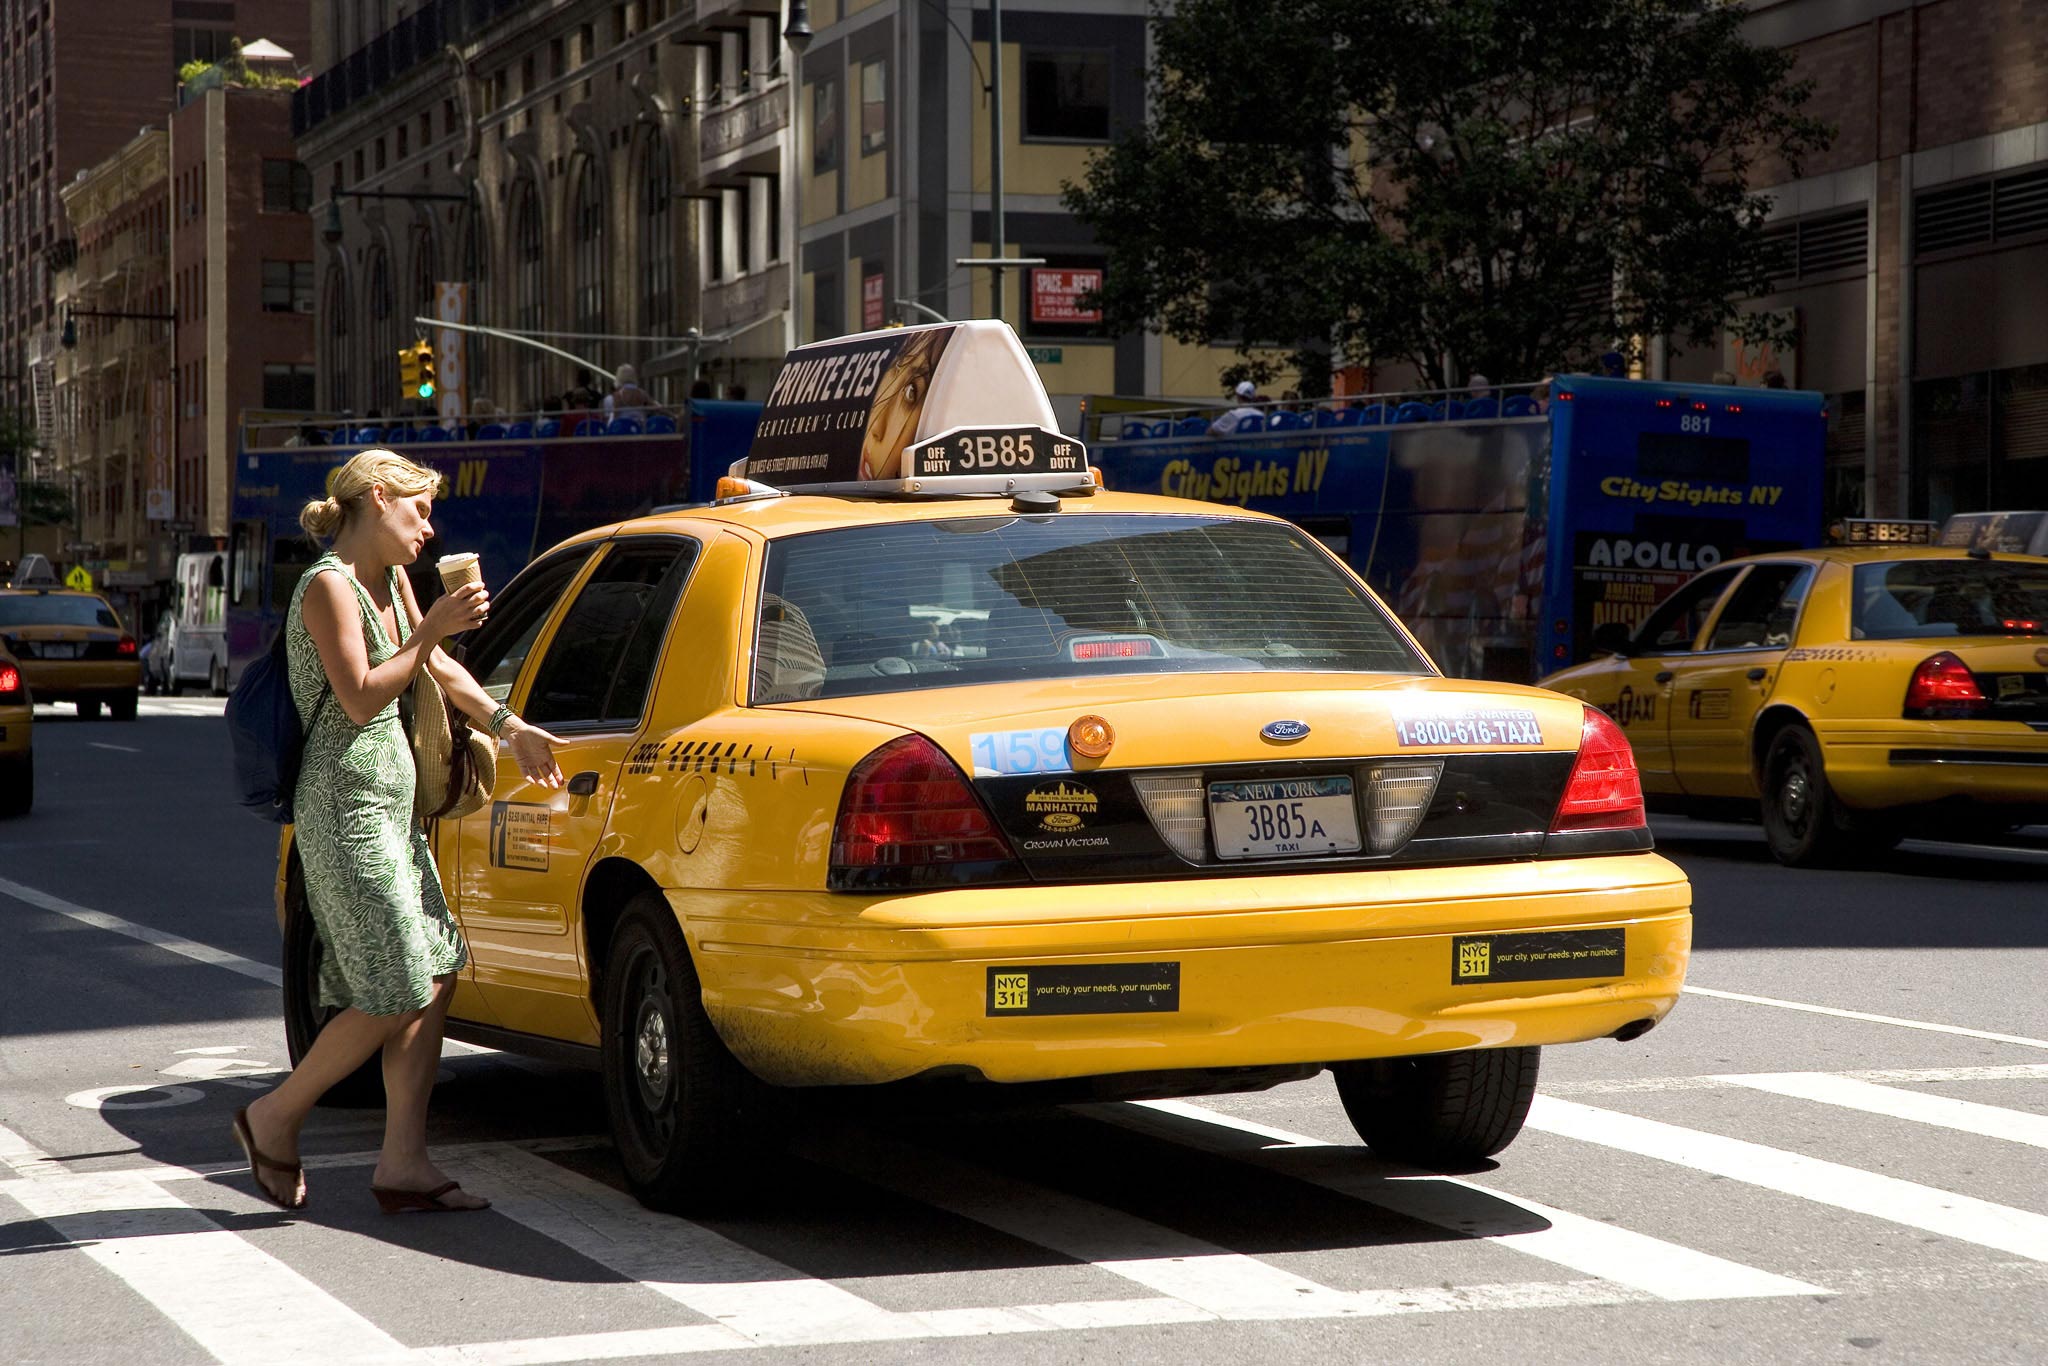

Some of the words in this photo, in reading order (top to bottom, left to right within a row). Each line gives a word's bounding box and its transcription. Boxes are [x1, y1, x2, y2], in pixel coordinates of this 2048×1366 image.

[1032, 350, 1050, 363] 50
[767, 355, 846, 408] PRIVATE
[833, 349, 891, 399] EYES
[757, 414, 830, 438] GENTLEMEN'S
[836, 409, 866, 430] CLUB
[1680, 414, 1711, 434] 881
[927, 446, 946, 460] OFF
[958, 434, 1034, 469] 3B85
[1054, 444, 1072, 456] OFF
[924, 459, 951, 473] DUTY
[1050, 456, 1076, 470] DUTY
[1293, 449, 1330, 493] NY
[455, 460, 488, 499] NY
[1748, 485, 1783, 506] NY
[1588, 537, 1721, 571] APOLLO
[1274, 722, 1300, 736] Ford
[1397, 720, 1541, 745] 1-800-616-TAXI
[977, 729, 1065, 773] 159
[1244, 782, 1277, 799] NEW
[1278, 780, 1319, 797] YORK
[1026, 802, 1097, 813] MANHATTAN
[1051, 815, 1073, 825] Ford
[1023, 840, 1063, 850] CROWN
[1065, 837, 1109, 848] VICTORIA
[1274, 842, 1301, 853] TAXI
[1462, 946, 1488, 958] NYC
[1497, 954, 1513, 963] your
[1515, 952, 1528, 963] city.
[1530, 952, 1546, 962] your
[1548, 950, 1571, 959] needs.
[1573, 951, 1588, 960] your
[1462, 960, 1486, 974] 311
[997, 977, 1026, 989] NYC
[1036, 986, 1053, 996] your
[1056, 985, 1071, 996] city.
[1073, 984, 1090, 995] your
[1093, 982, 1118, 993] needs.
[1120, 983, 1137, 994] your
[1140, 981, 1172, 992] number.
[998, 991, 1026, 1006] 311
